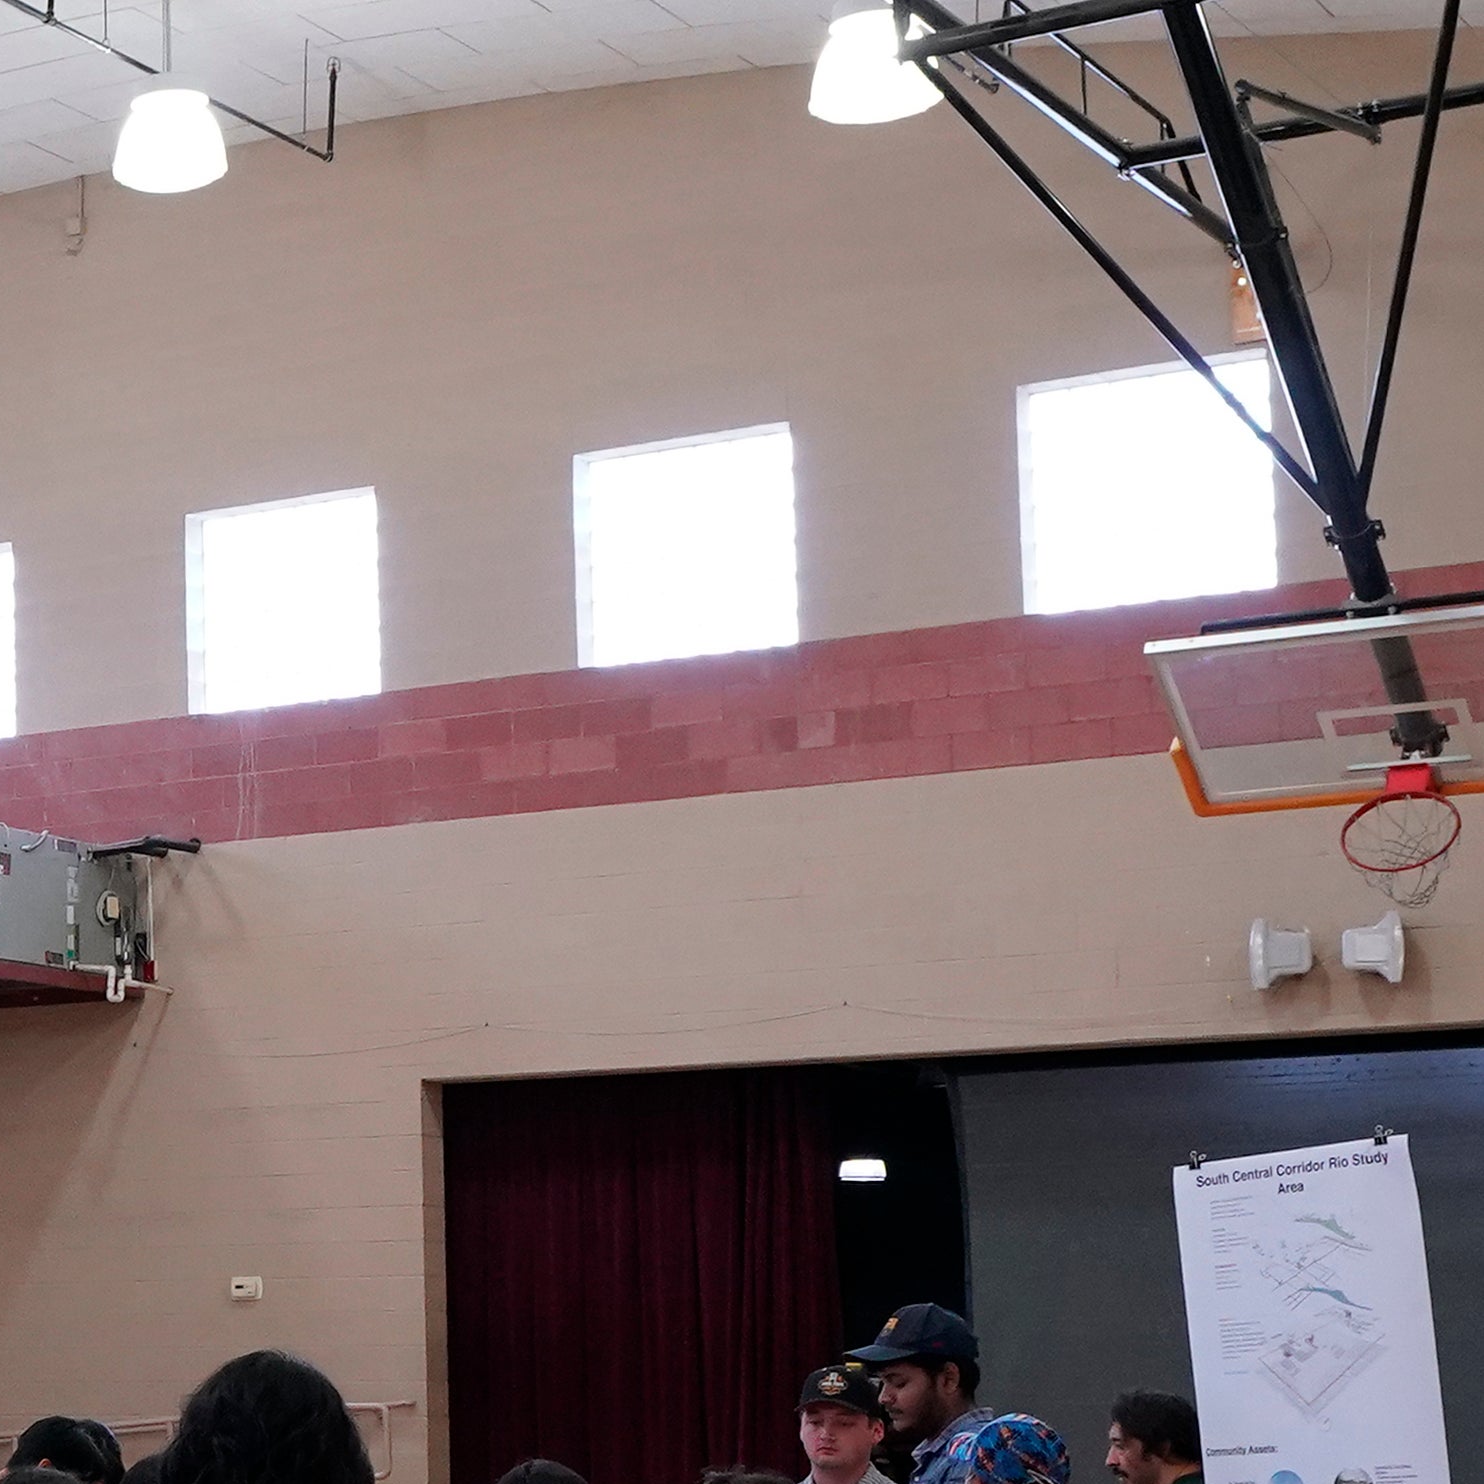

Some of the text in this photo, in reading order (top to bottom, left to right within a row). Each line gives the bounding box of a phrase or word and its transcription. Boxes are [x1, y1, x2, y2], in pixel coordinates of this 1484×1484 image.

[1196, 1151, 1389, 1188] South Central Corridor Rio Study
[1278, 1182, 1304, 1194] Area
